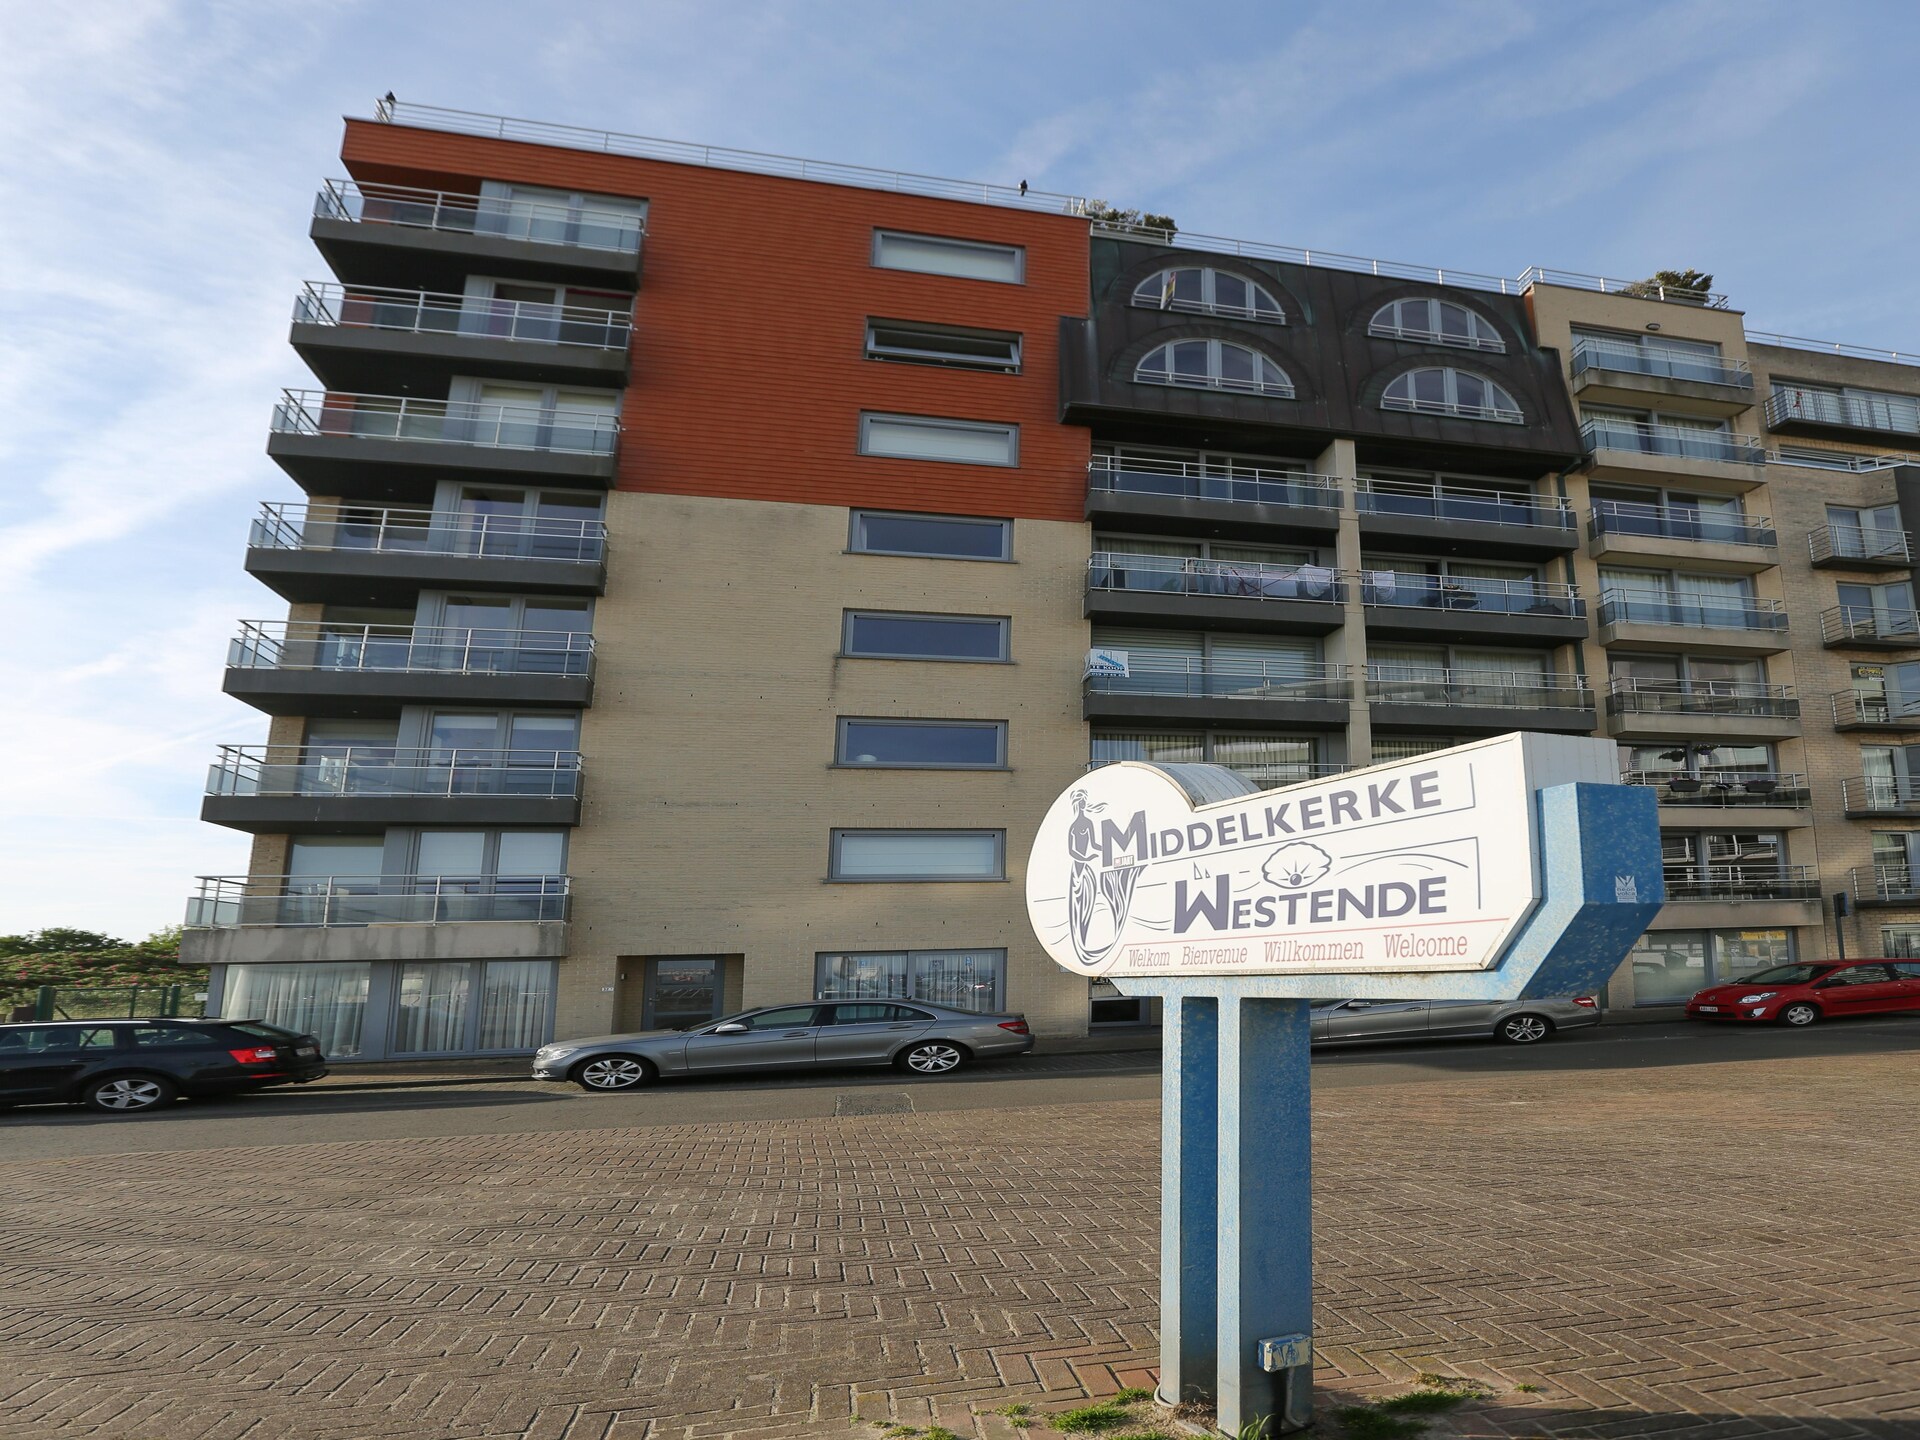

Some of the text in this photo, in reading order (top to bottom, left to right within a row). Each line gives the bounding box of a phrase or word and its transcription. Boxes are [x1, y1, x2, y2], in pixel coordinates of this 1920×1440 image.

[1102, 770, 1442, 867] MIDDELKERKE
[1174, 874, 1447, 934] WESTENDE
[1128, 933, 1468, 967] Welkom Bienvenue Willkommen Welcome
